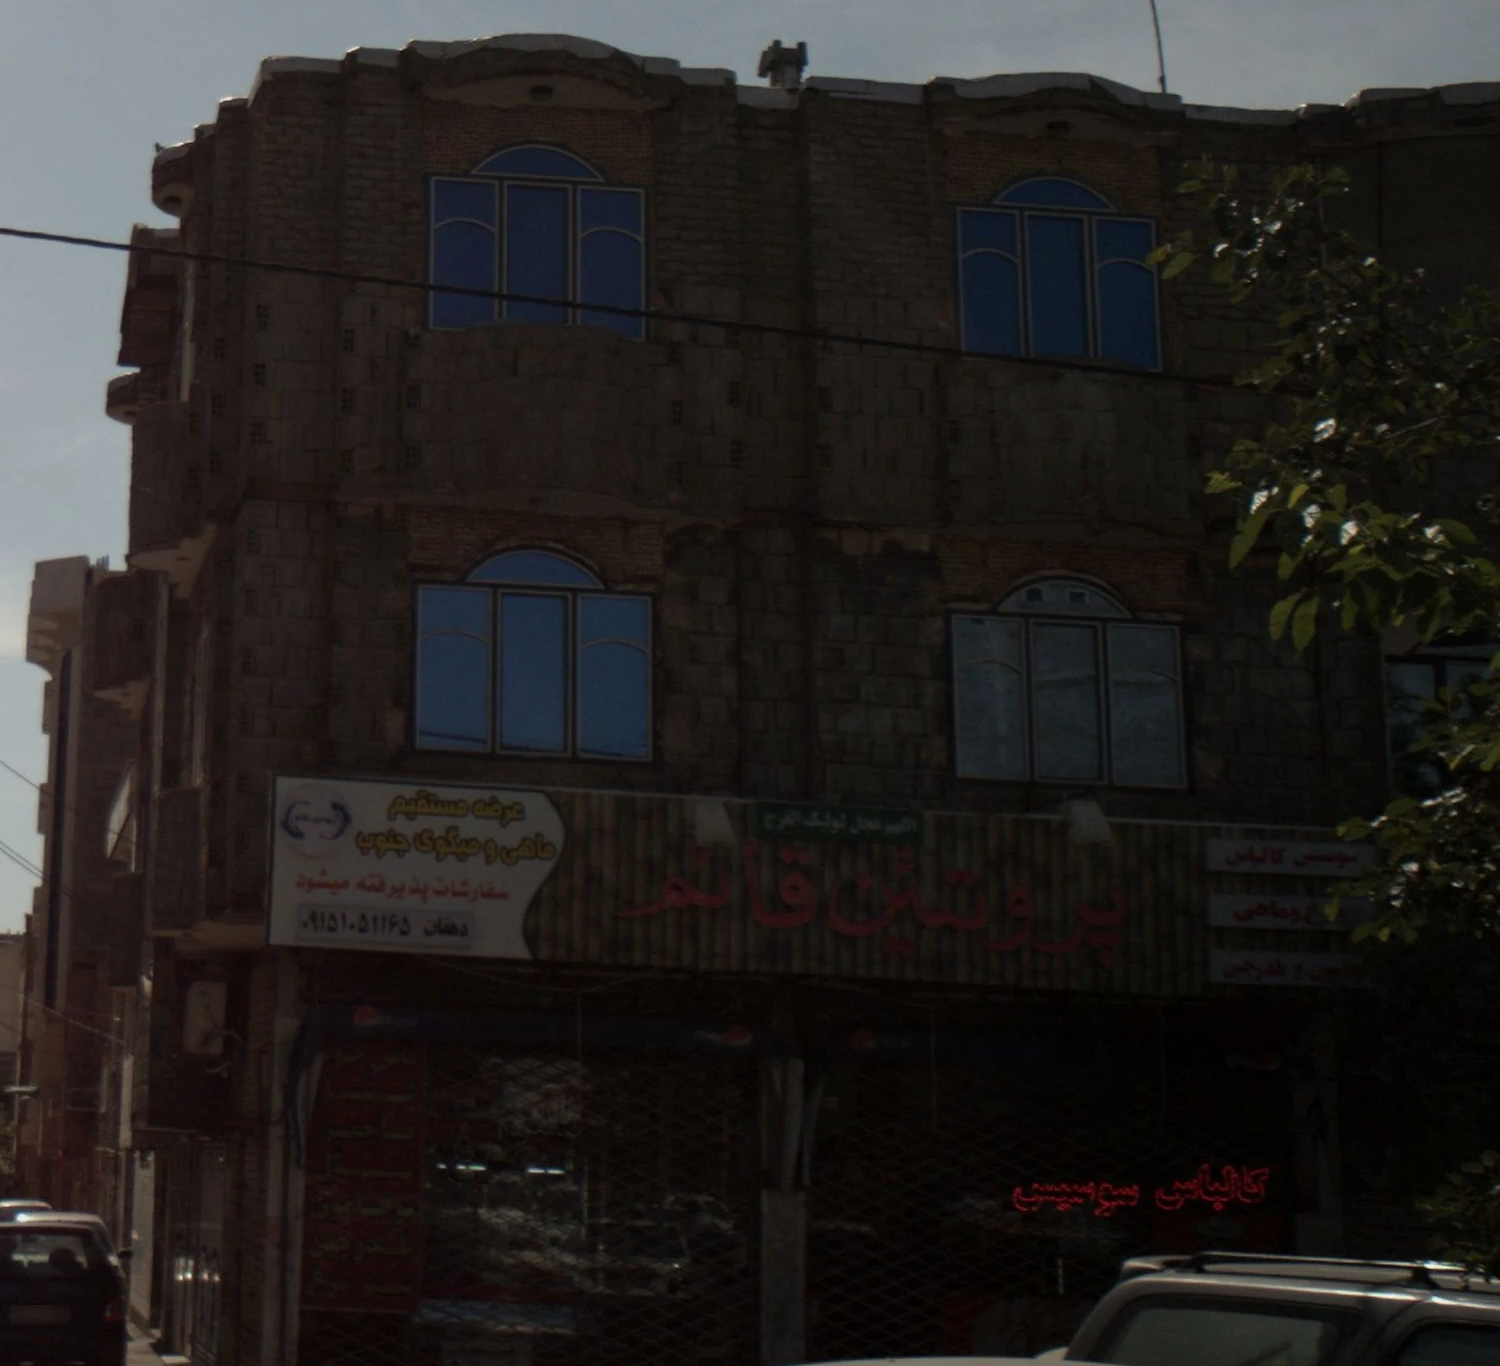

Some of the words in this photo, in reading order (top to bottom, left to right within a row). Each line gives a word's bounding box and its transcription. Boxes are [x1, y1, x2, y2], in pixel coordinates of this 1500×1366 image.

[387, 790, 469, 820] مستقیم
[471, 795, 524, 828] عرضه
[355, 828, 410, 859] جنوب
[414, 825, 481, 862] میگوی
[484, 839, 498, 865] و
[501, 833, 556, 866] ماهی
[296, 868, 349, 895] میشود
[356, 873, 428, 904] پذیرفته
[432, 876, 508, 902] سفارشات
[829, 846, 1126, 967] پروتئین
[1012, 1181, 1140, 1219] سوسیس
[1155, 1162, 1269, 1211] کالباس
